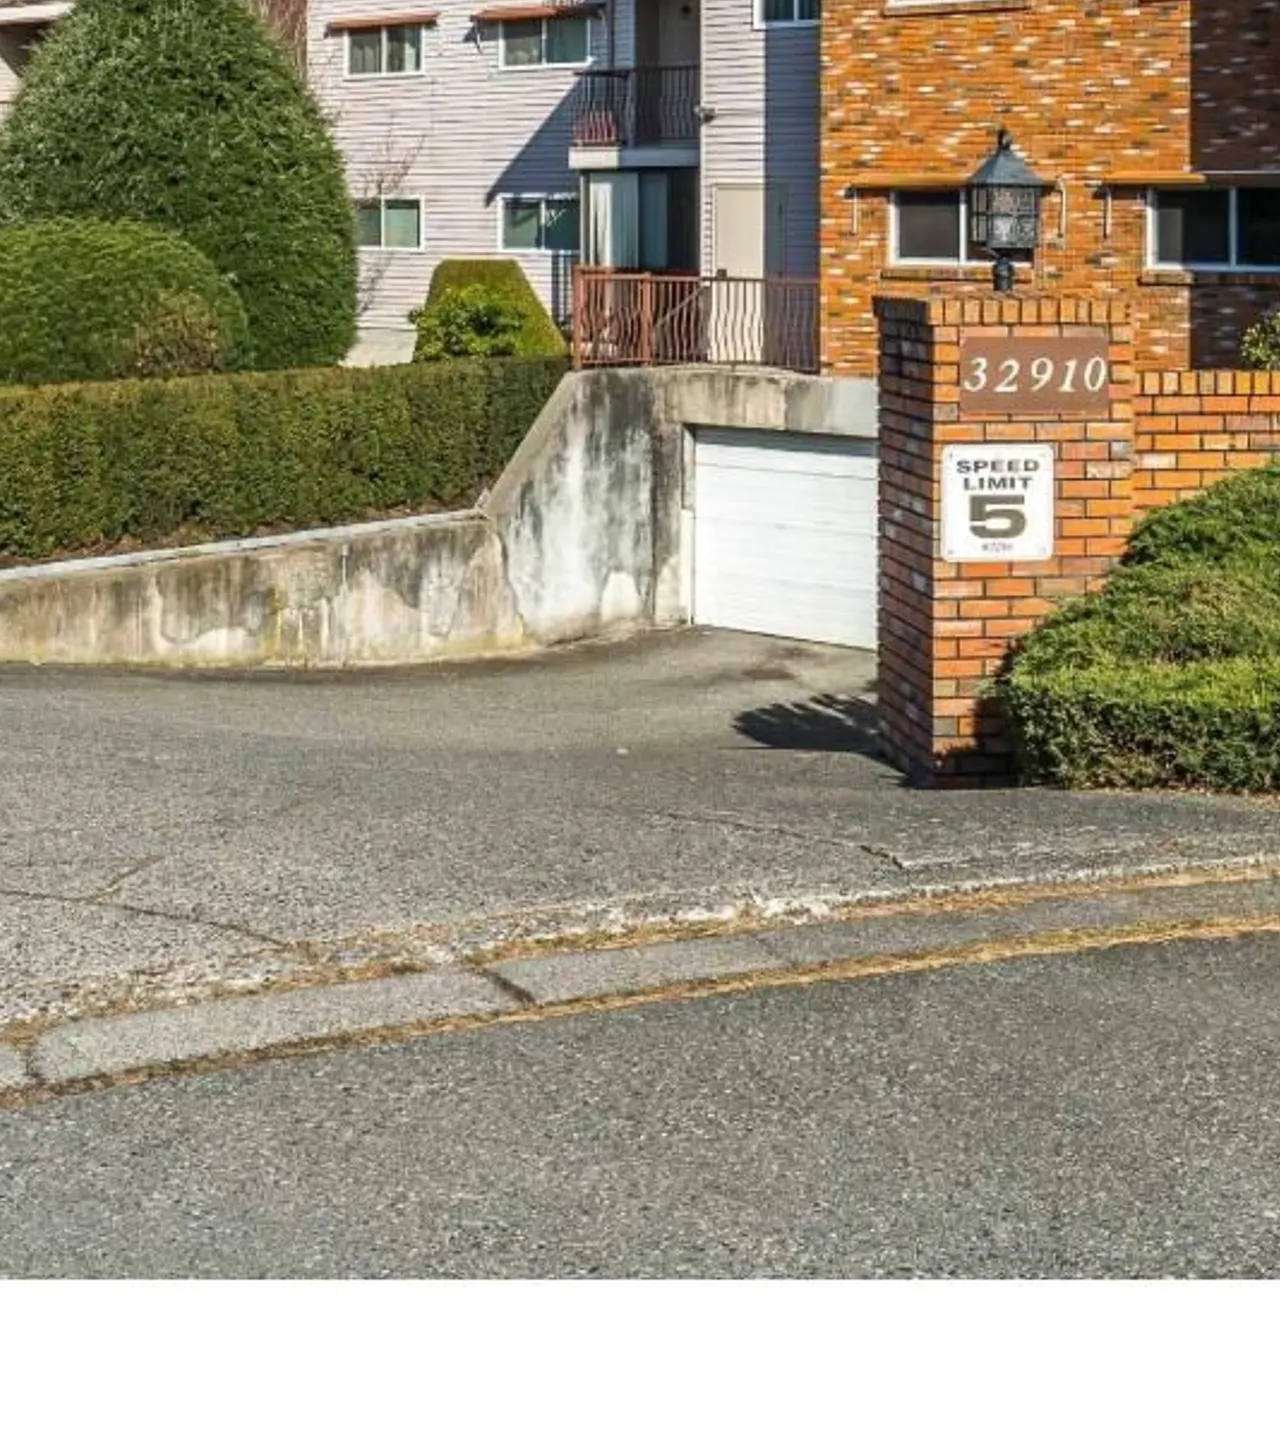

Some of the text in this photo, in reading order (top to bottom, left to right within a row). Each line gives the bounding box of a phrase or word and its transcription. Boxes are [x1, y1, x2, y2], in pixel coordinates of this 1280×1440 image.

[964, 356, 1108, 393] 32910
[956, 458, 1041, 474] SPEED
[963, 476, 1033, 492] LIMIT
[969, 494, 1027, 539] 5
